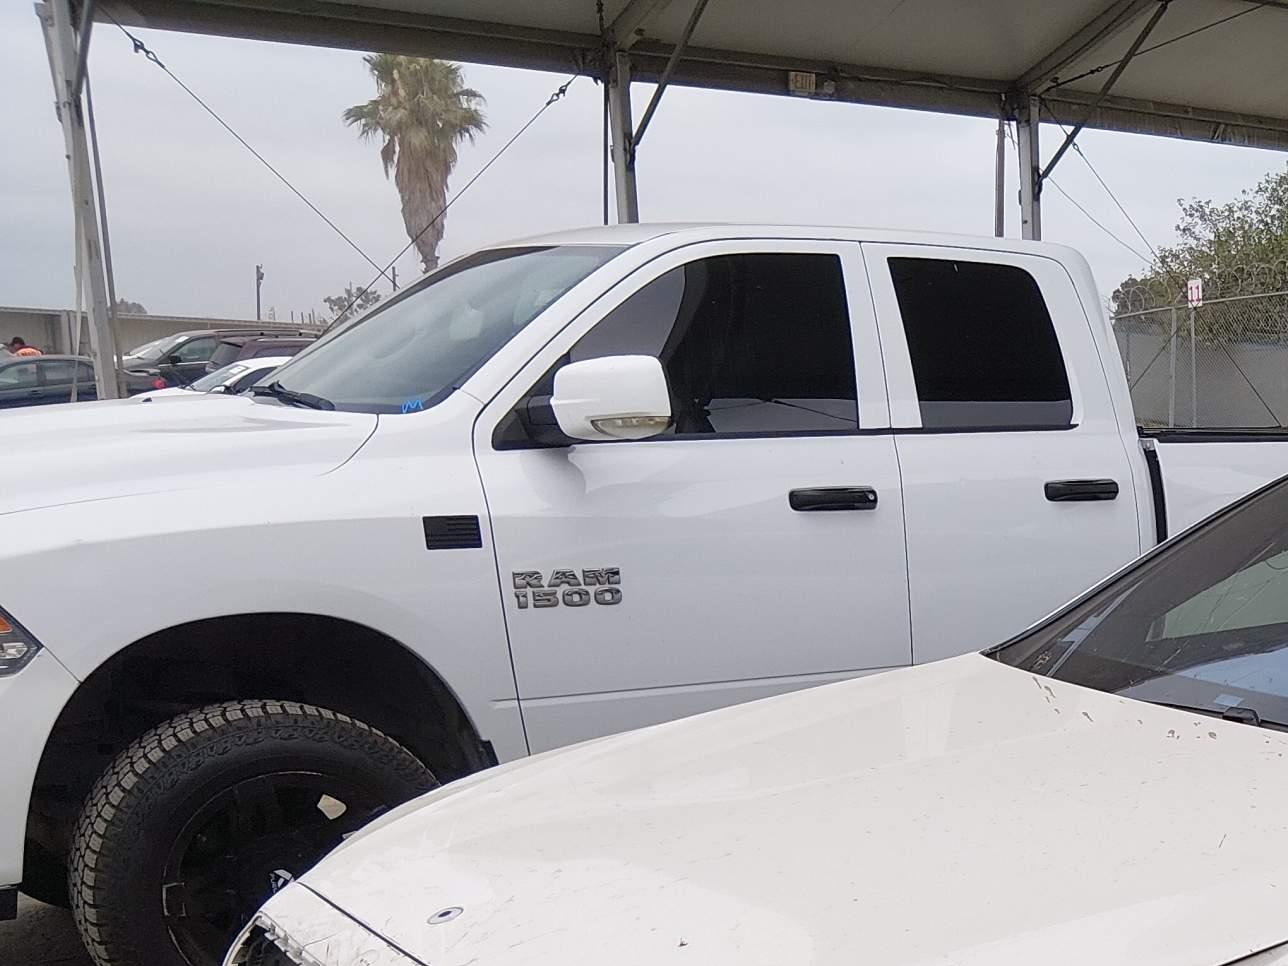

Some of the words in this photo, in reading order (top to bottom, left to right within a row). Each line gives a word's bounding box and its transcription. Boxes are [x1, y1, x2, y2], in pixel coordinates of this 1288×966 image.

[1188, 284, 1202, 302] 11
[512, 567, 621, 589] RAM
[514, 586, 623, 609] 1500
